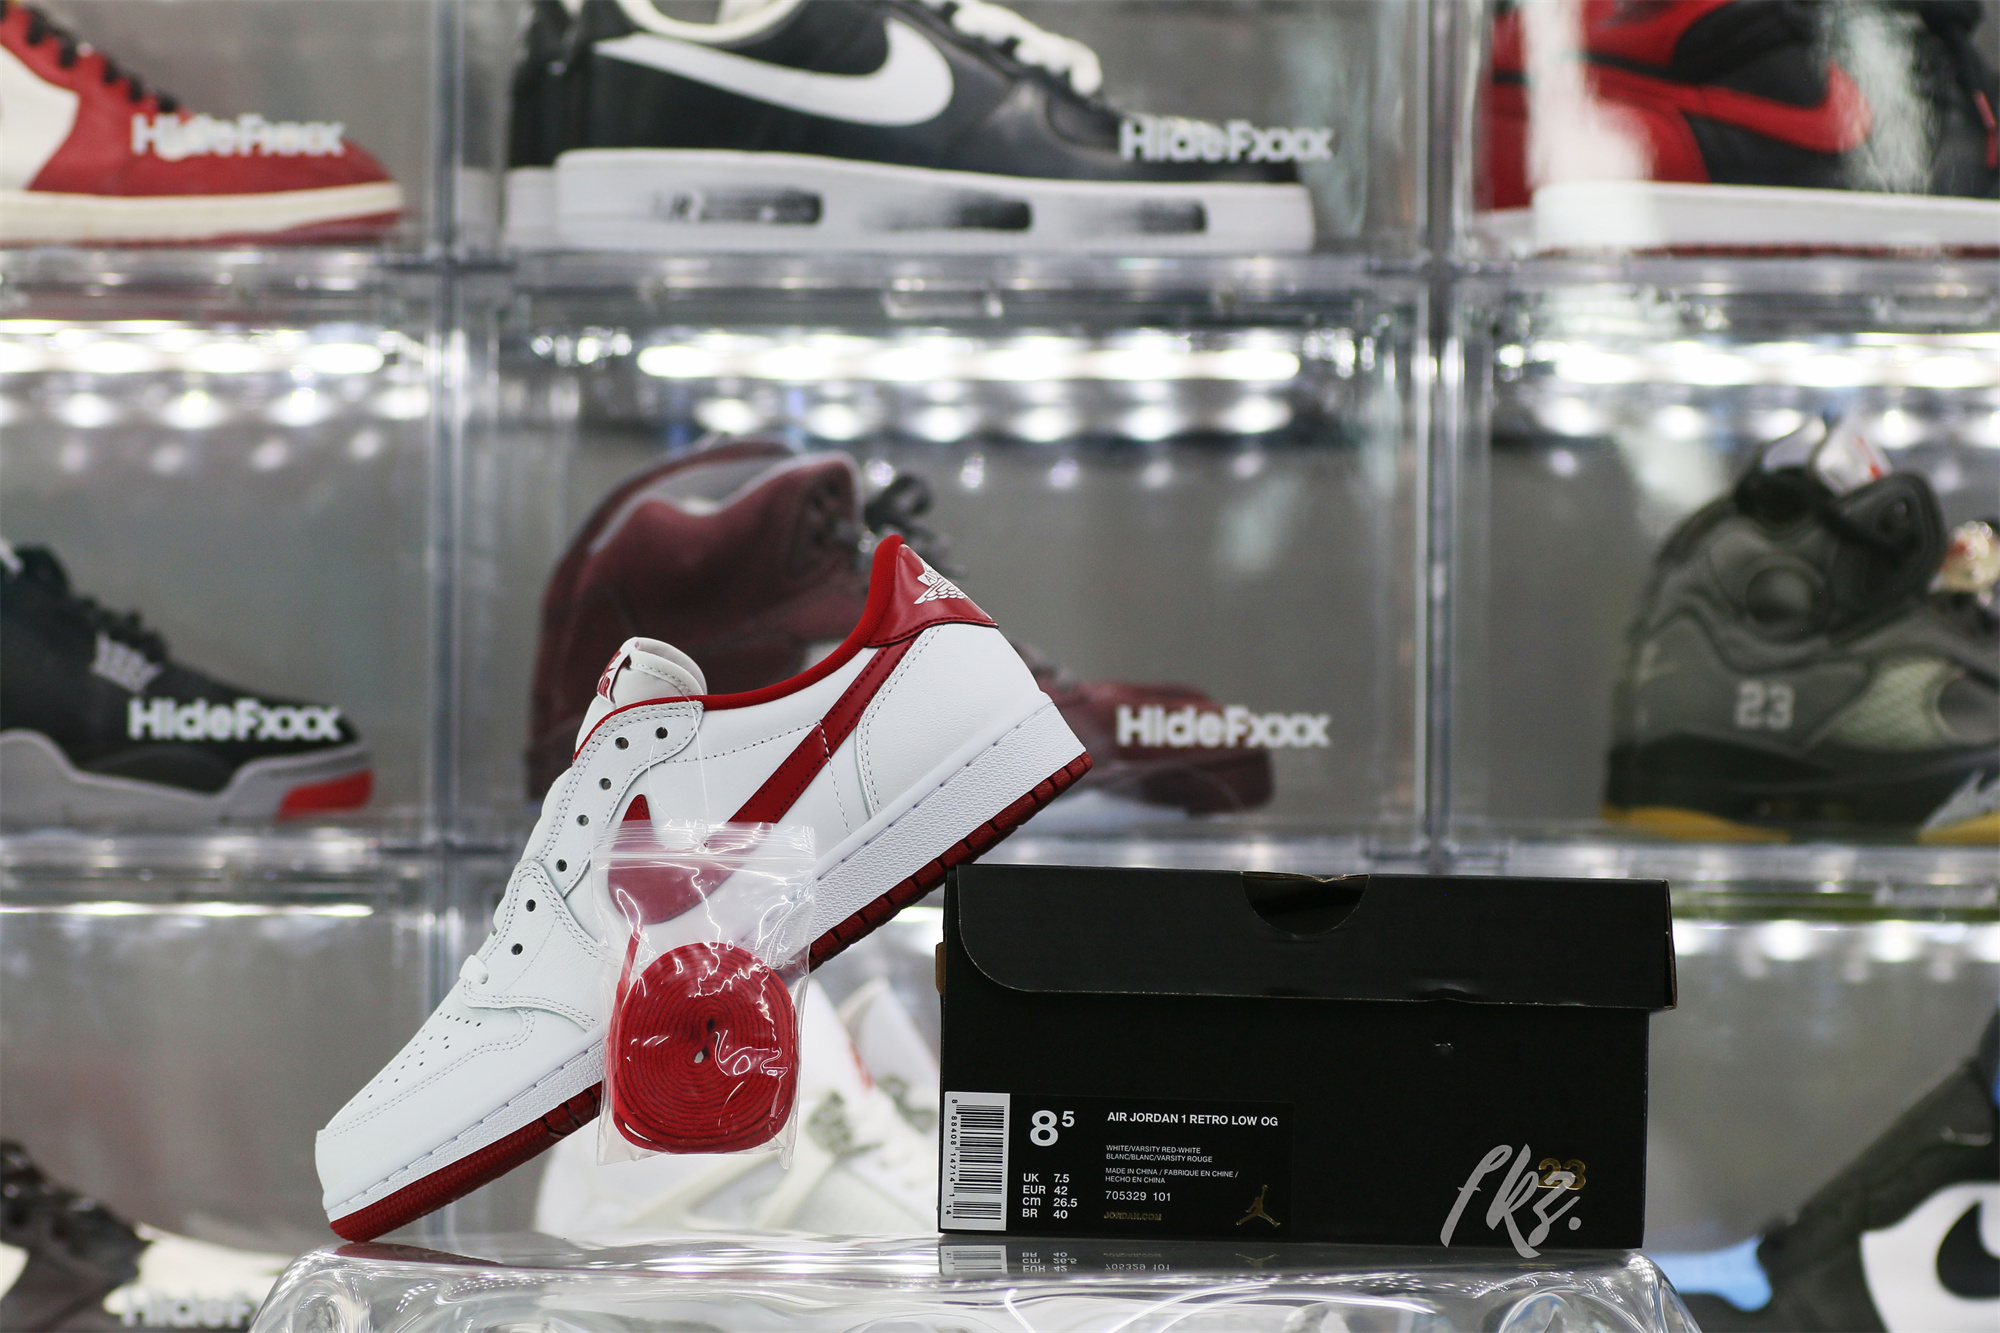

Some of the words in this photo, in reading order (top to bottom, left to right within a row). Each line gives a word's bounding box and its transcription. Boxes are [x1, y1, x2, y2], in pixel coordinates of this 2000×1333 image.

[1119, 118, 1333, 162] HideFxxx
[1736, 681, 1794, 729] 23
[128, 697, 341, 741] HideFxxx
[1117, 704, 1330, 748] HideFxxx
[1107, 1112, 1128, 1122] AIR
[1129, 1112, 1179, 1123] JORDAN
[1181, 1114, 1187, 1124] 1
[1189, 1114, 1229, 1125] RETRO
[1231, 1115, 1258, 1126] LOW
[1261, 1116, 1278, 1126] OG
[1030, 1110, 1059, 1147] 8
[1106, 1145, 1160, 1153] WHITE/VARSITY
[1161, 1146, 1201, 1154] RED-WHITE
[1106, 1153, 1186, 1162] BLANC/BLANC/VARSITY
[1187, 1155, 1213, 1163] ROUGE
[1105, 1167, 1126, 1175] MADE
[1164, 1169, 1199, 1177] FABRIQUE
[1212, 1170, 1234, 1178] CHINE
[1023, 1173, 1040, 1183] UK
[1053, 1173, 1070, 1184] 7.5
[1022, 1185, 1046, 1195] EUR
[1053, 1186, 1068, 1196] 42
[1105, 1190, 1147, 1201] 705329
[1153, 1192, 1171, 1202] 101
[1022, 1197, 1041, 1206] cm
[1053, 1198, 1078, 1208] 26.5
[945, 1204, 952, 1215] 14
[1022, 1208, 1038, 1218] BR
[1053, 1209, 1068, 1219] 40
